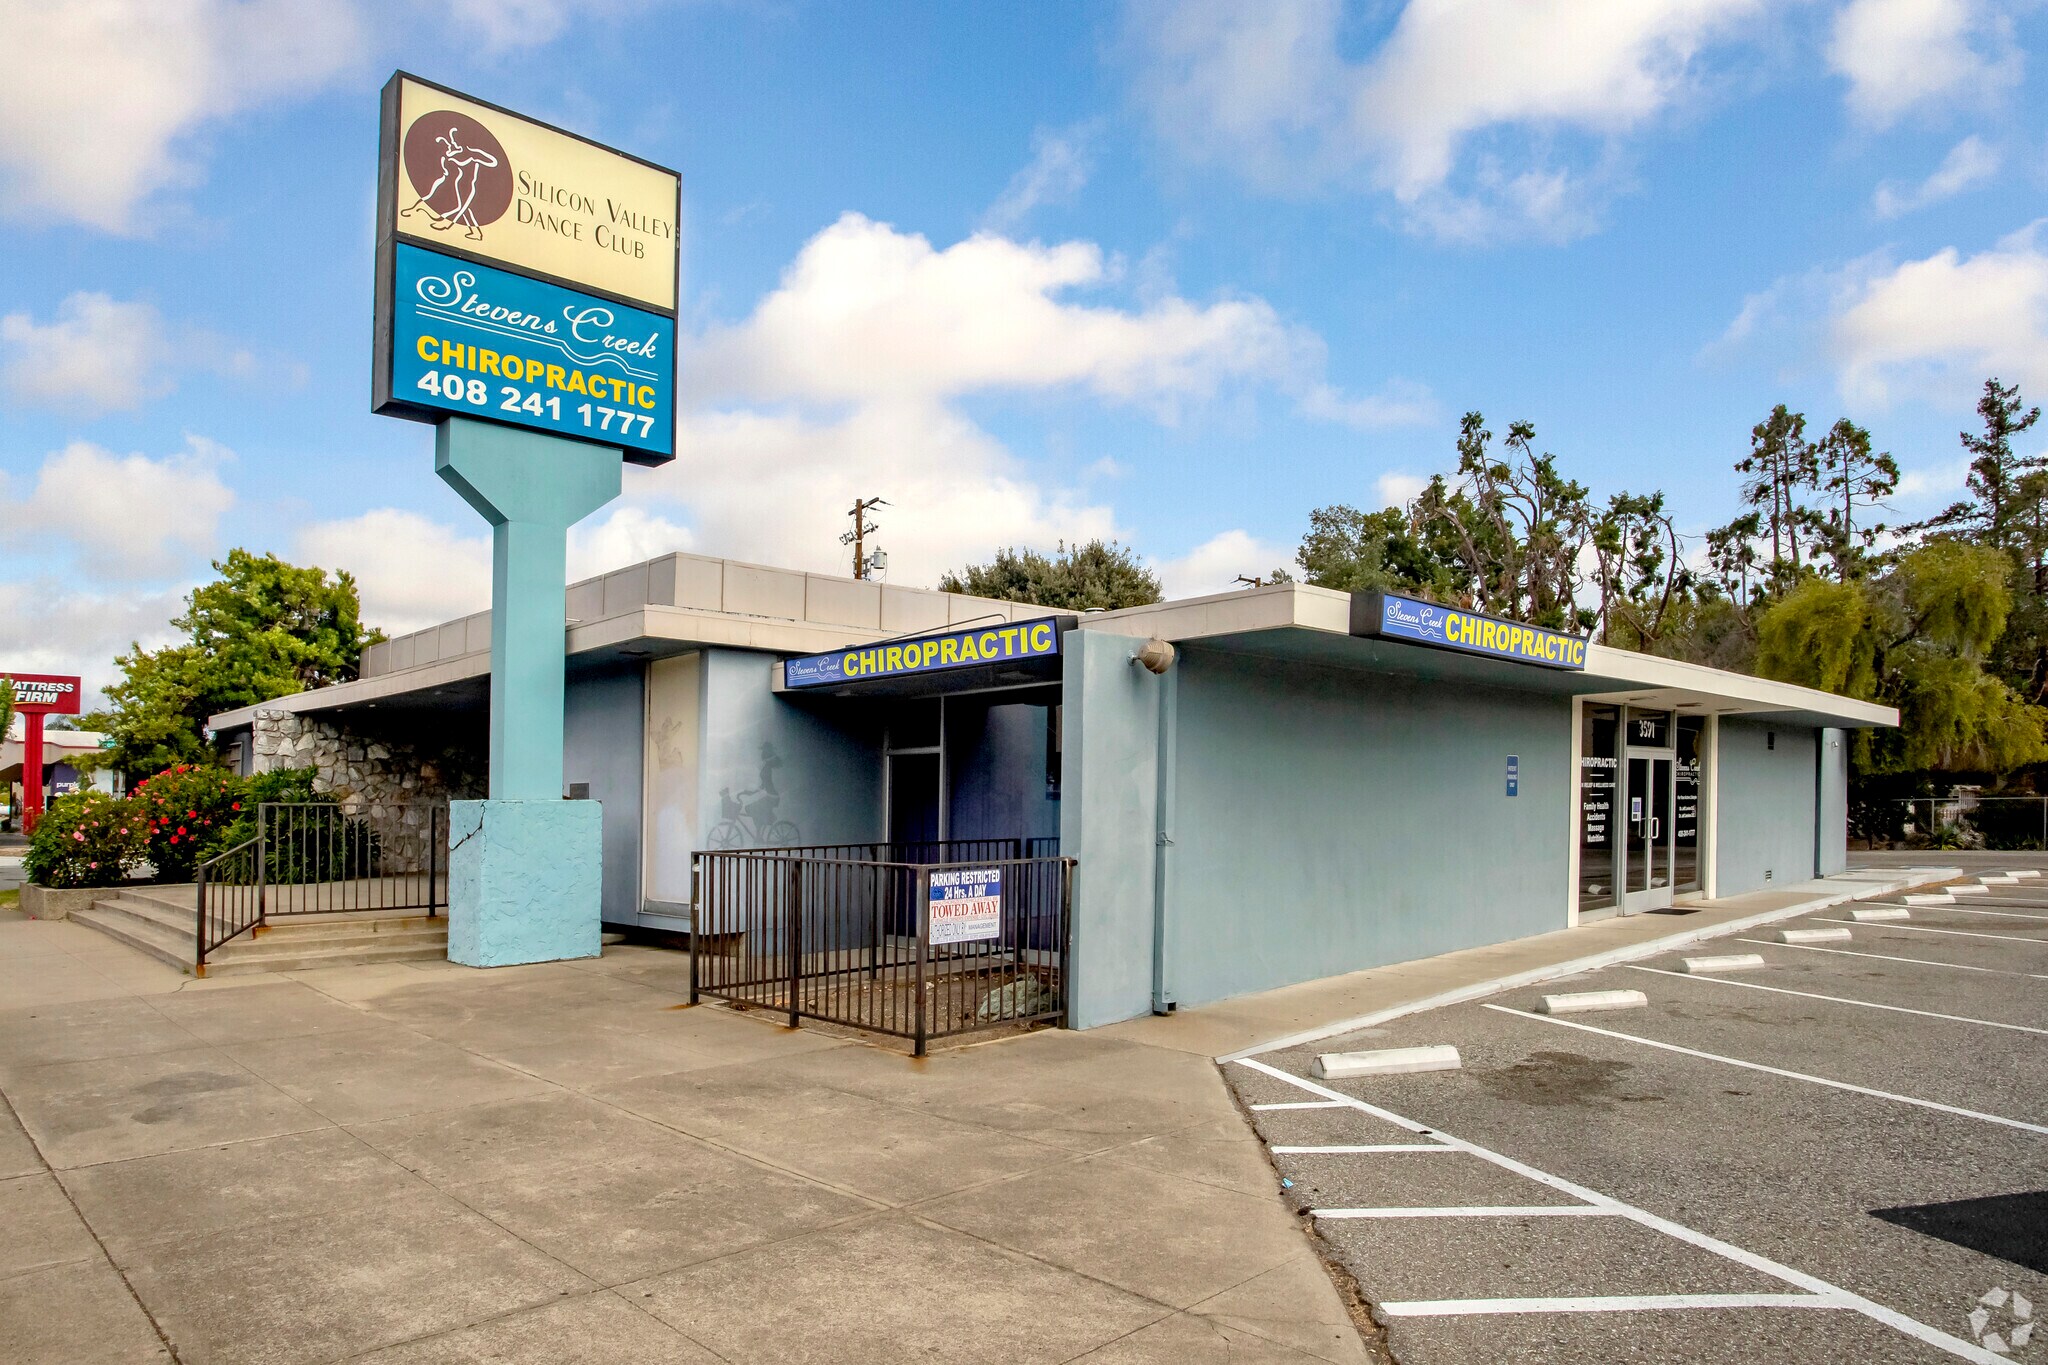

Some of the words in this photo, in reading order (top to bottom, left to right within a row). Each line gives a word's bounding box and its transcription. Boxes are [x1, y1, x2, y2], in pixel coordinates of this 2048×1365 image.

[517, 169, 595, 217] SILICON
[606, 198, 673, 239] VALLEY
[516, 198, 582, 241] DANCE
[595, 225, 645, 260] CLUB
[416, 270, 558, 335] Stevens
[563, 304, 659, 359] Creek
[416, 335, 656, 410] CHIROPRACTIC
[417, 370, 488, 405] 408
[500, 388, 561, 421] 241
[577, 402, 655, 439] 1777
[1387, 601, 1420, 624] Stevens
[1420, 608, 1443, 629] Creek
[1445, 612, 1584, 665] CHIROPRACTIC
[789, 656, 817, 675] Stevens
[817, 656, 840, 672] Creek
[843, 623, 1052, 677] CHIROPRACTIC
[15, 690, 58, 703] FIRM
[1638, 720, 1655, 738] 3591
[1581, 757, 1617, 768] HIROPRACTIC
[56, 781, 78, 789] purpl
[1583, 802, 1597, 812] Family
[1597, 801, 1609, 810] Health
[1586, 812, 1606, 821] Accidents
[931, 872, 960, 886] PARKING
[961, 870, 1000, 884] RESTRICTED
[944, 887, 953, 899] 24
[953, 886, 967, 899] Hrs.
[968, 885, 973, 898] A
[974, 884, 987, 897] DAY
[931, 903, 969, 919] TOWED
[970, 900, 998, 915] AWAY
